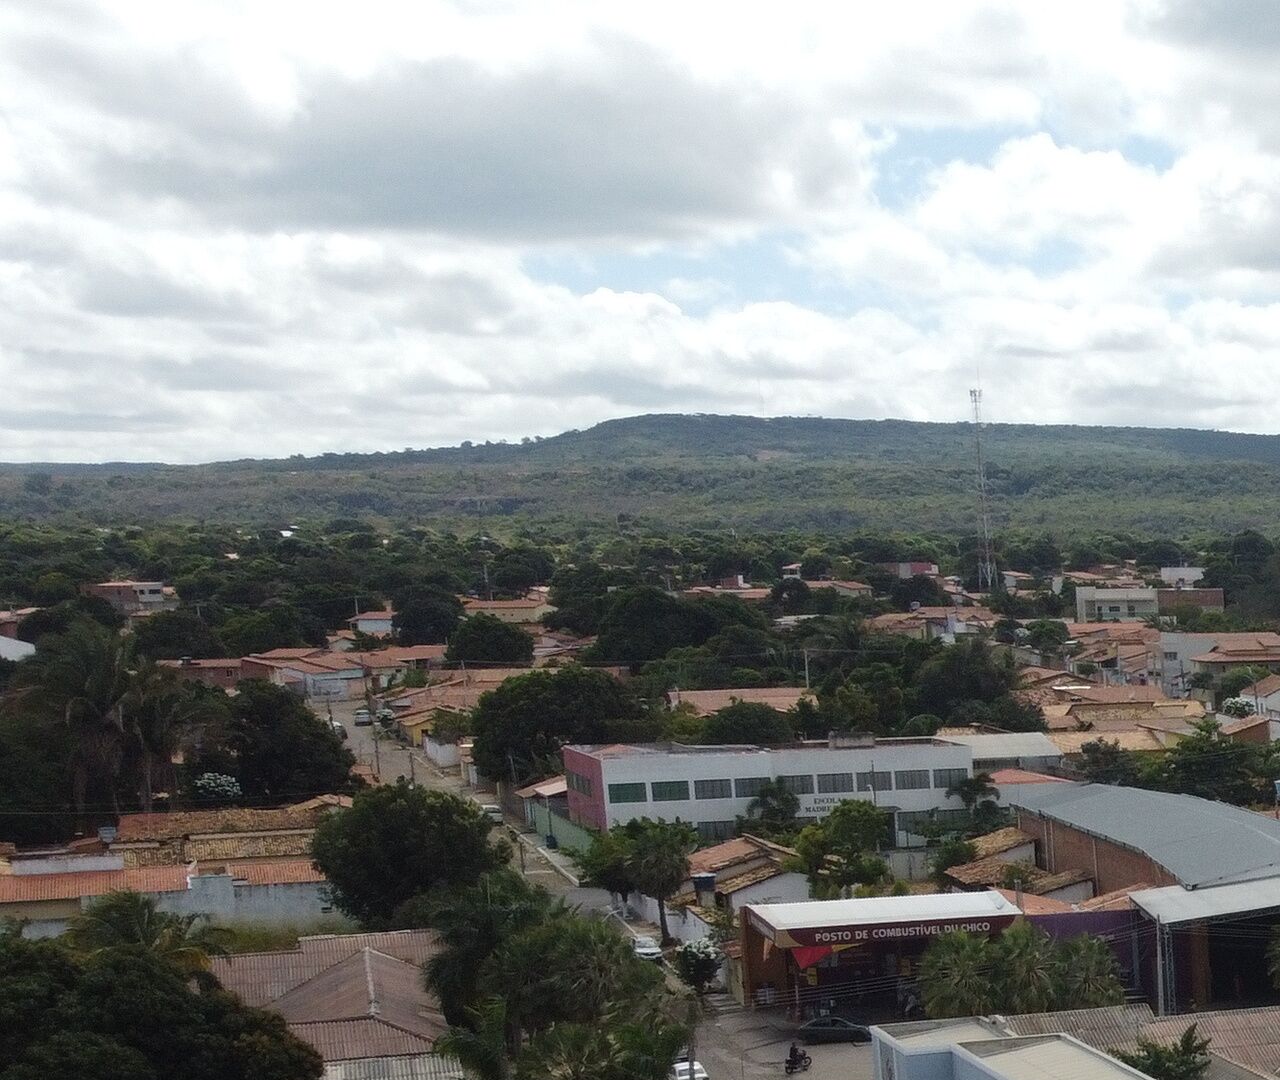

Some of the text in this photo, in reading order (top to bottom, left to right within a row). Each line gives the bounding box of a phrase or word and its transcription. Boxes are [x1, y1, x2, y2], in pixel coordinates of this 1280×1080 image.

[815, 931, 852, 942] POSTO
[855, 930, 869, 940] DE
[872, 924, 942, 939] COMBUSTÍVEL
[961, 922, 990, 932] CHICO
